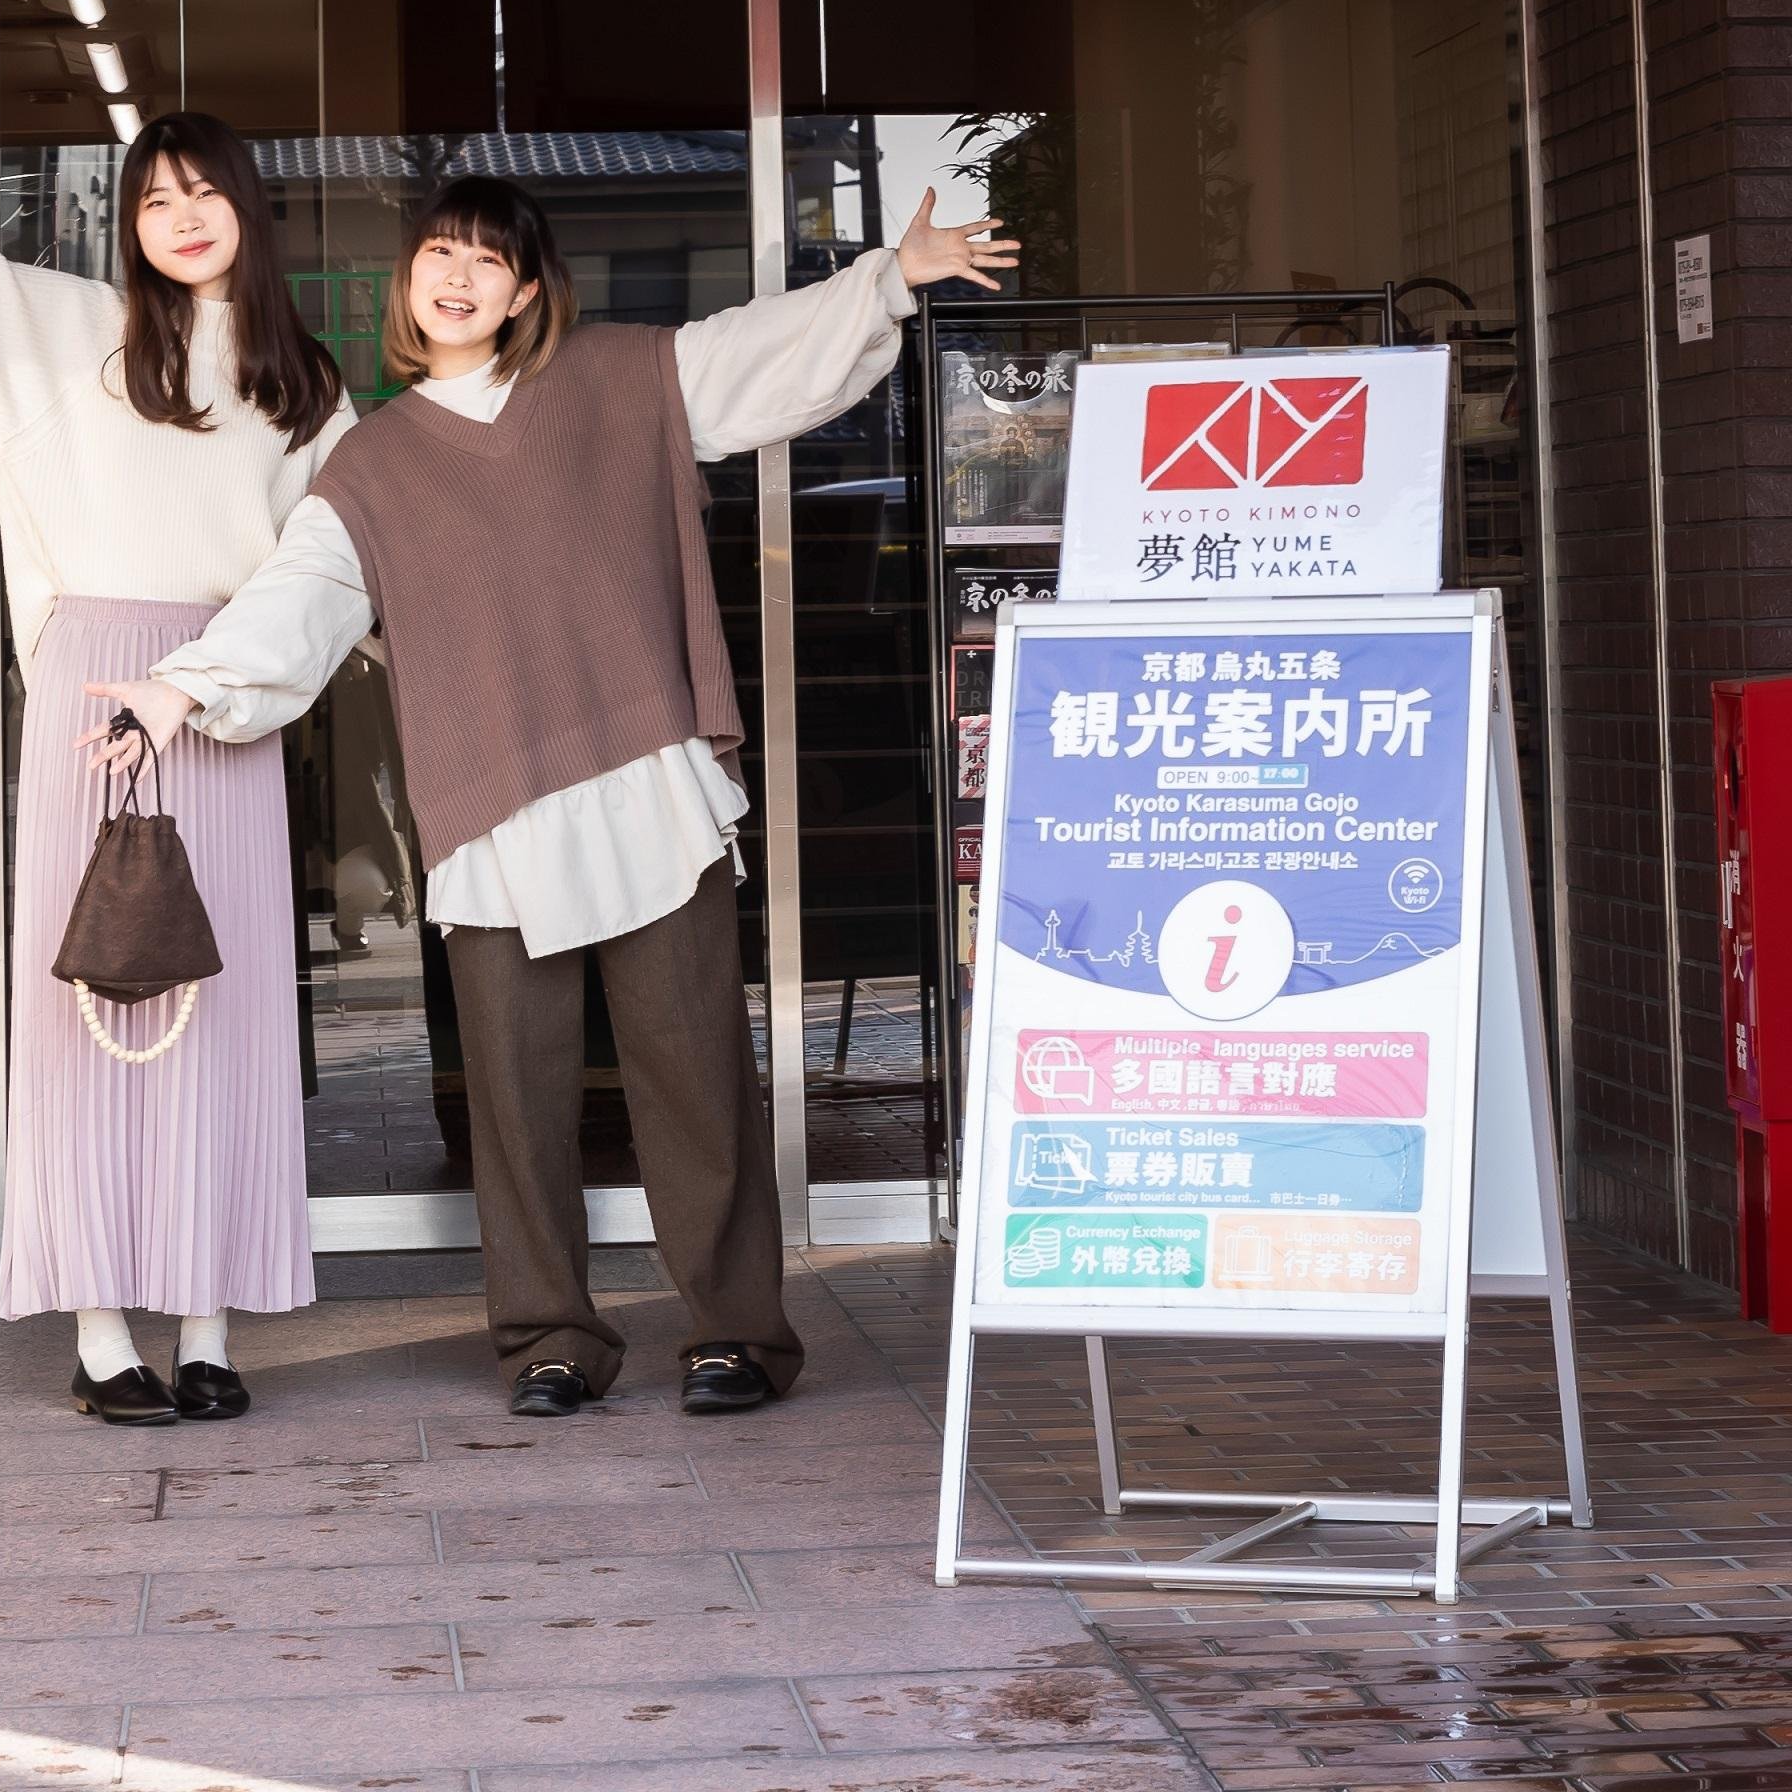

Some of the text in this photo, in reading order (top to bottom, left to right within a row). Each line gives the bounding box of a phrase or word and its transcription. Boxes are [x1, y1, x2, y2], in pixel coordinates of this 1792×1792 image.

[955, 363, 1073, 395] 京の冬の旅
[1142, 504, 1362, 525] KYOTO KIMONO
[1251, 535, 1334, 553] YUME
[1136, 532, 1242, 584] 夢館
[1250, 559, 1359, 579] YAKATA
[965, 582, 1060, 613] 京の冬の
[1142, 651, 1207, 683] 京都
[1048, 687, 1433, 759] 観光案内所
[964, 744, 985, 788] 京都
[1163, 770, 1209, 785] OPEN
[1113, 793, 1359, 817] Kyoto Karasuma Gojo
[1034, 815, 1439, 842] Tourist Information Center
[1106, 850, 1358, 872] 교토 가라스마고조 관광안내소
[1113, 1037, 1415, 1063] Multiple languages service
[1111, 1058, 1338, 1098] 多國語言對應
[1106, 1127, 1239, 1148] Ticket Sales
[1104, 1150, 1255, 1188] 票券販賣
[1105, 1191, 1137, 1205] Kyoto
[1139, 1191, 1176, 1203] tourist
[1178, 1191, 1198, 1206] city
[1199, 1191, 1222, 1204] bus
[1065, 1225, 1201, 1243] Currency Exchange
[1284, 1229, 1413, 1249] Luggage Storage
[1070, 1245, 1192, 1277] 外幣兌換
[1283, 1250, 1407, 1281] 行李寄存
